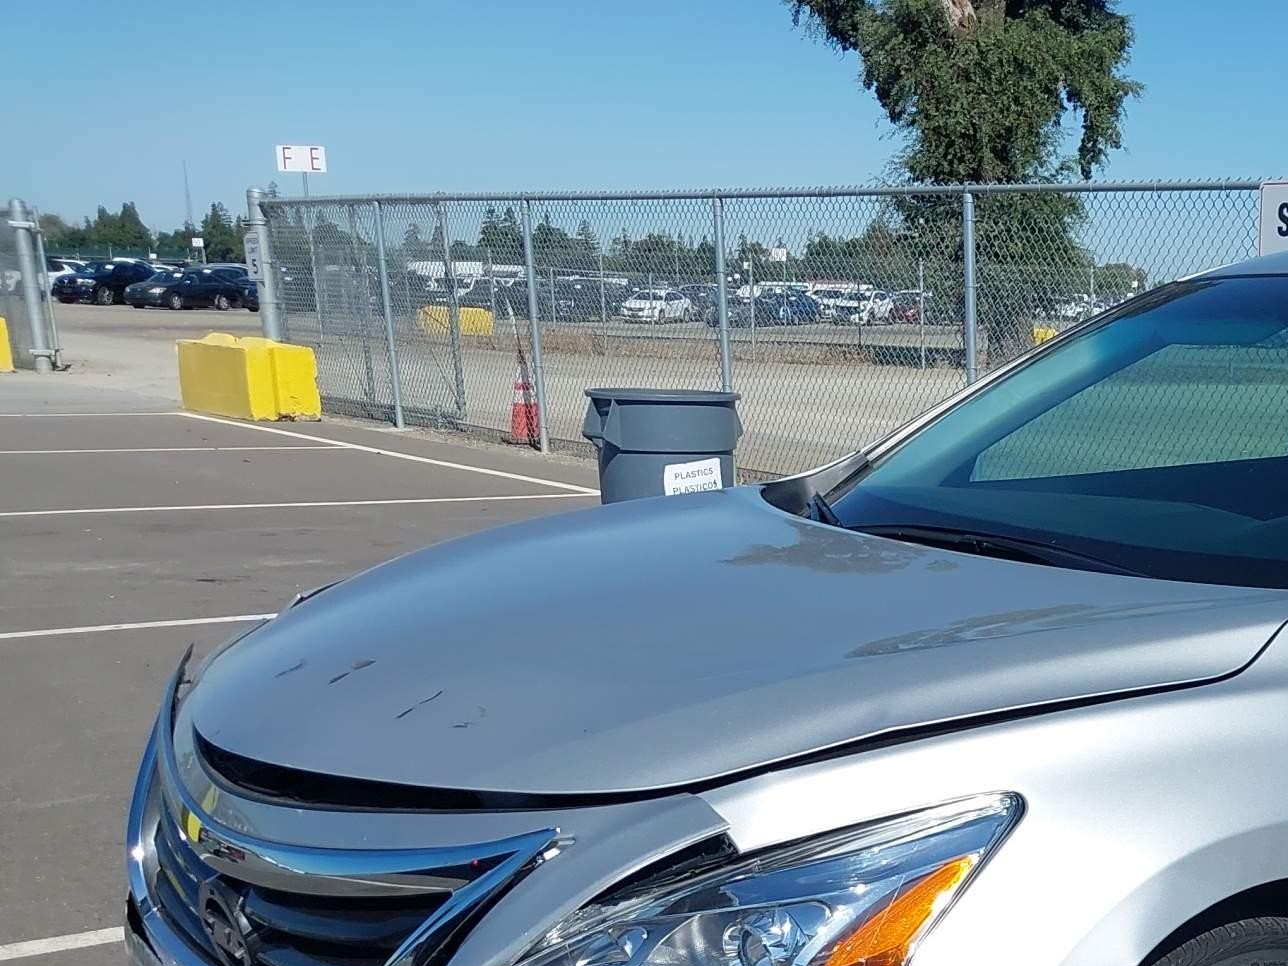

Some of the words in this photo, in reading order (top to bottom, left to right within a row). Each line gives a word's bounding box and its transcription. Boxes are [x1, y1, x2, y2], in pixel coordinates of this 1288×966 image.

[282, 146, 292, 170] F
[310, 147, 321, 170] E
[674, 468, 713, 480] PLASTICS
